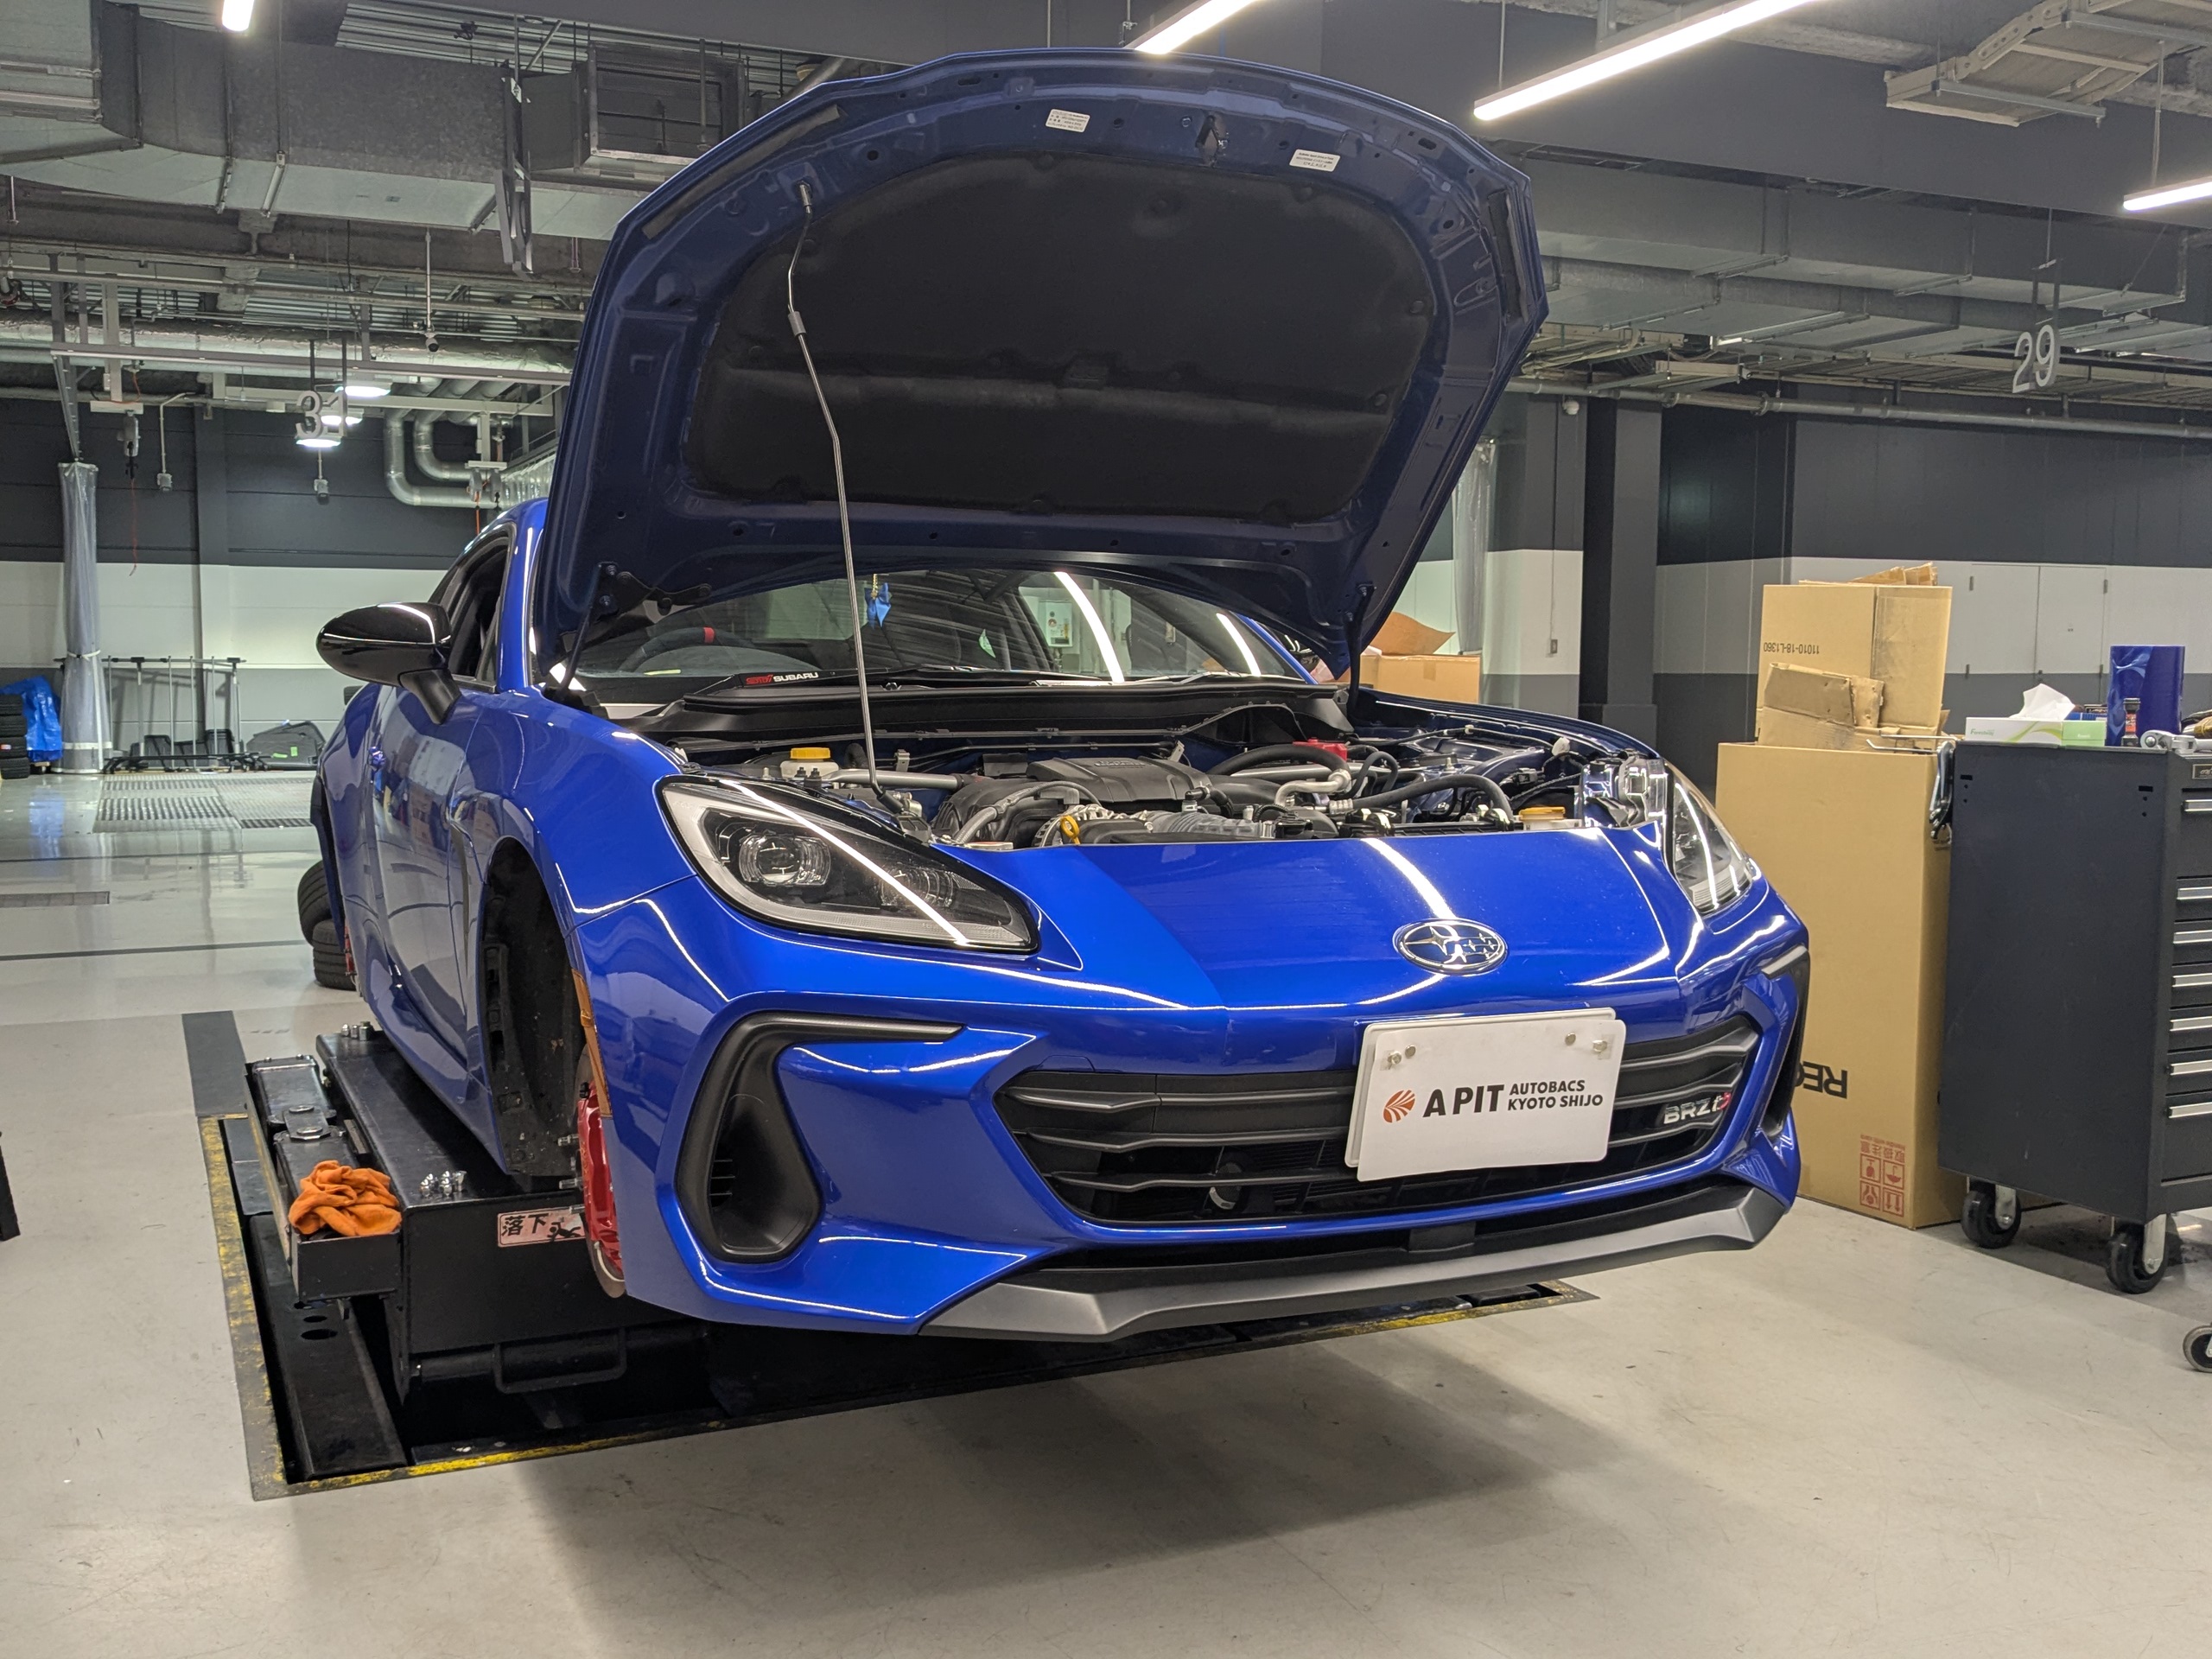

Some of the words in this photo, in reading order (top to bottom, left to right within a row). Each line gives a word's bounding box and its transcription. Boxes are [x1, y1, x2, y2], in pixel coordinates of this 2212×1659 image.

[2012, 325, 2055, 394] 29
[295, 391, 346, 439] 31
[773, 672, 819, 683] SUBARU
[1509, 1080, 1586, 1096] AUTOBACS
[1507, 1096, 1556, 1111] KYOTO
[1559, 1094, 1603, 1108] SHIJO
[1663, 1097, 1711, 1124] BRZ
[501, 1213, 550, 1236] 落下
